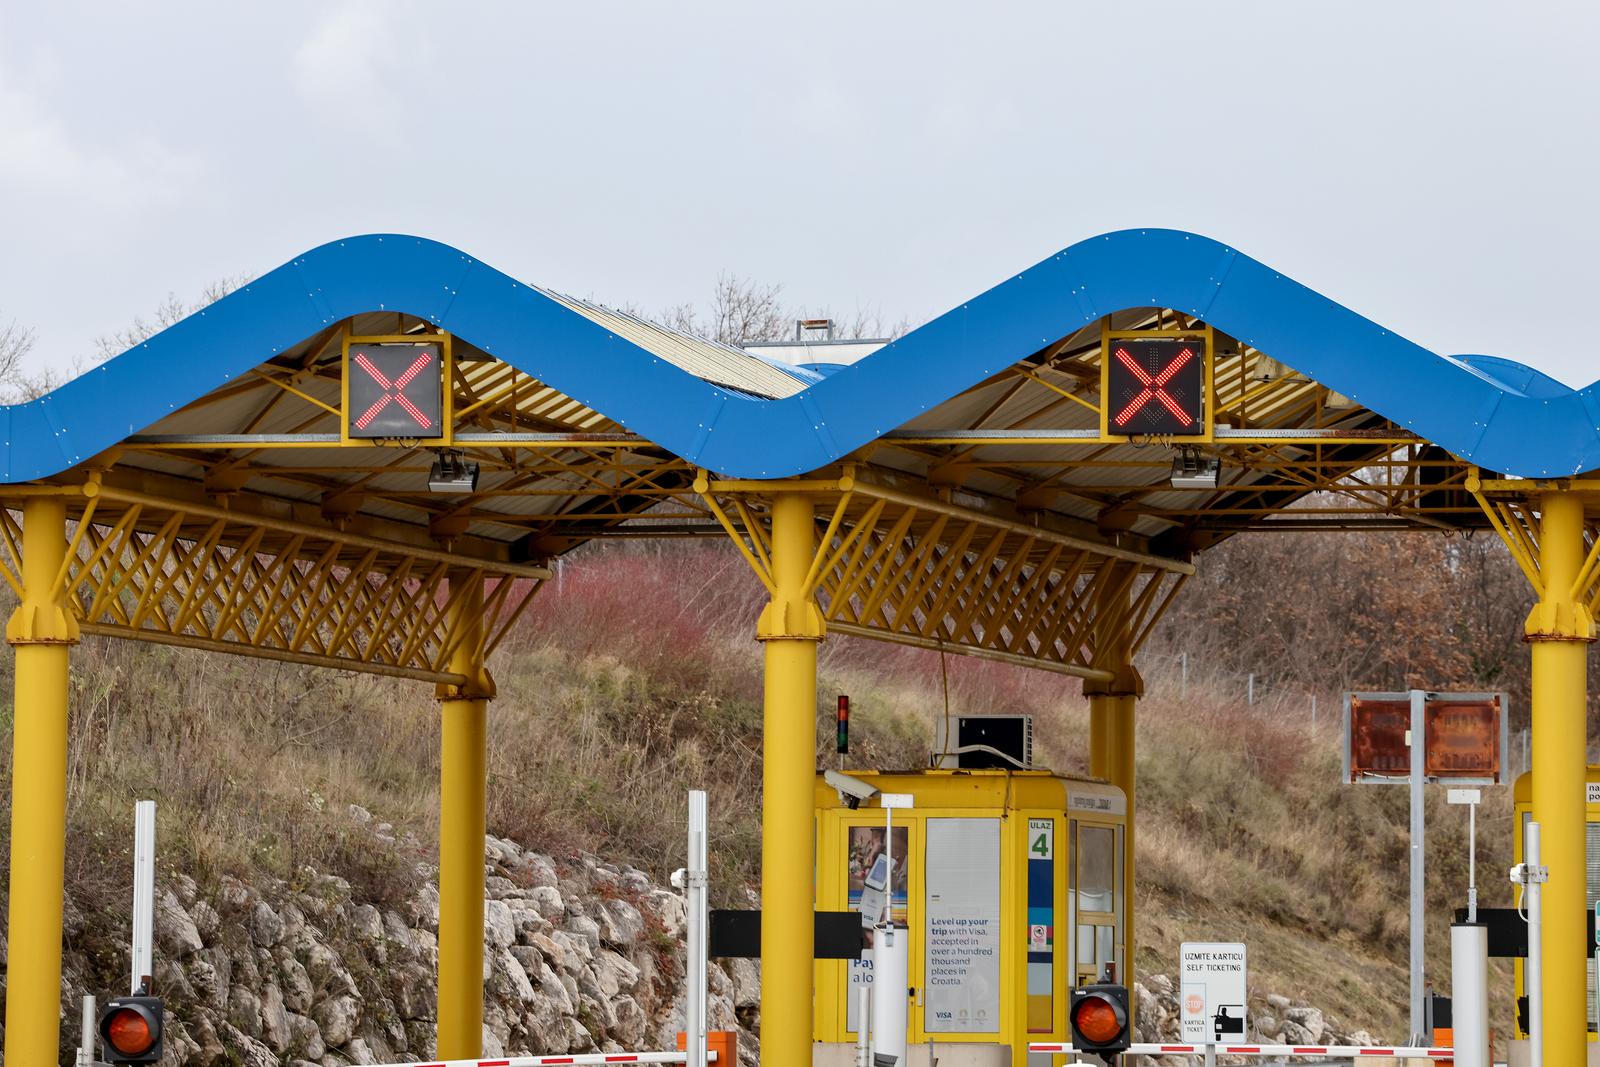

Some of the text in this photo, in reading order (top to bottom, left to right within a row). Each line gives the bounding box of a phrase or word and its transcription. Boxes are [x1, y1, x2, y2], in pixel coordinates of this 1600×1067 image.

[1030, 822, 1051, 830] ULAZ
[1032, 833, 1049, 856] 4
[956, 919, 967, 927] up
[968, 919, 988, 927] your
[931, 927, 988, 936] trip with Visa,
[931, 938, 969, 947] accepted
[957, 947, 993, 955] hundred
[931, 957, 971, 965] thousand
[1185, 953, 1243, 961] UZMITE KARTICU
[931, 967, 967, 976] places in
[1207, 964, 1241, 972] TICKETING
[853, 975, 860, 983] a
